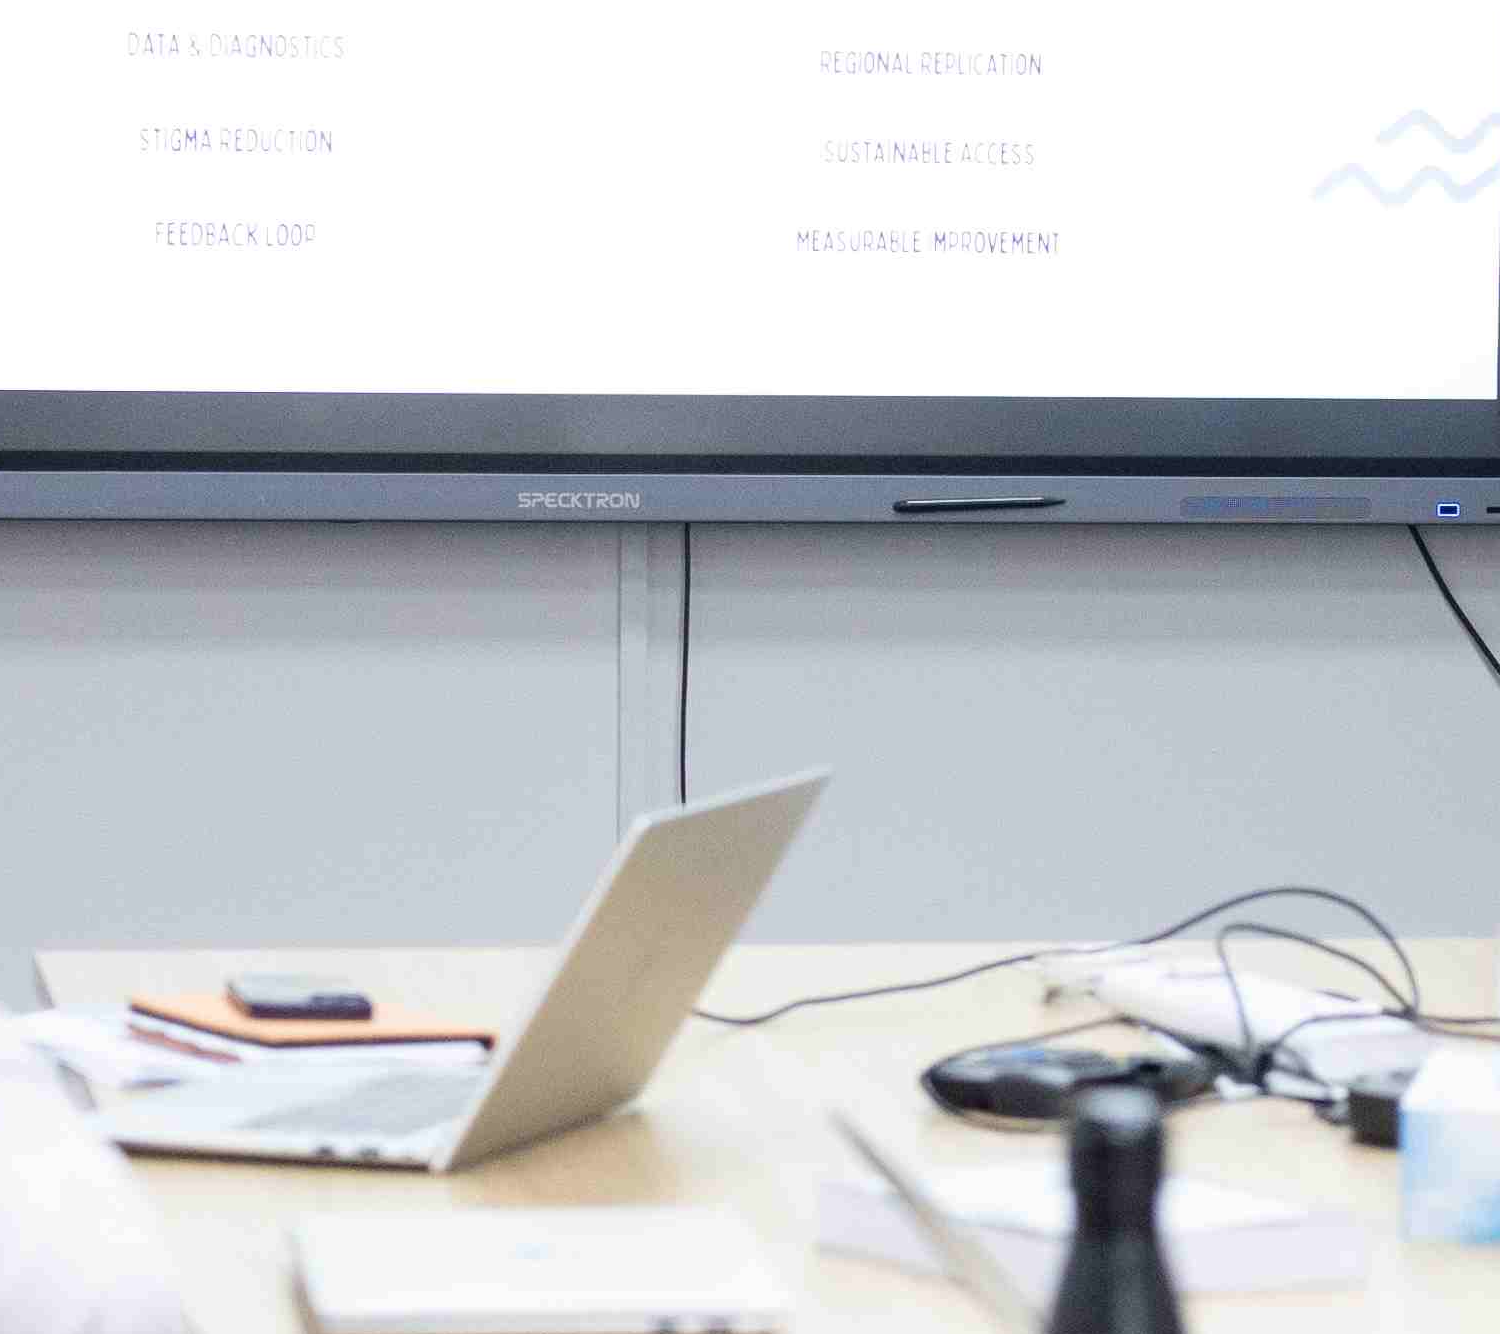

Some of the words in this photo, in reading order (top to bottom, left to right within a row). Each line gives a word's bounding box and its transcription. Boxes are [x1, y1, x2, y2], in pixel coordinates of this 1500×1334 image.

[125, 30, 181, 58] DATA
[189, 32, 203, 58] &
[209, 32, 346, 59] DIAGNOSTICS
[819, 50, 914, 76] REGIONAL
[920, 51, 1044, 76] REPLICATION
[139, 126, 213, 154] STIGMA
[218, 127, 334, 154] REDUCTION
[823, 140, 953, 165] SUSTAINABLE
[959, 141, 1036, 166] ACCESS
[155, 221, 260, 247] FEEDBACK
[265, 222, 317, 247] LOOP
[795, 229, 922, 253] MEASURABLE
[924, 230, 1061, 255] MPROVEMENT
[517, 492, 640, 509] SPECKTRON
